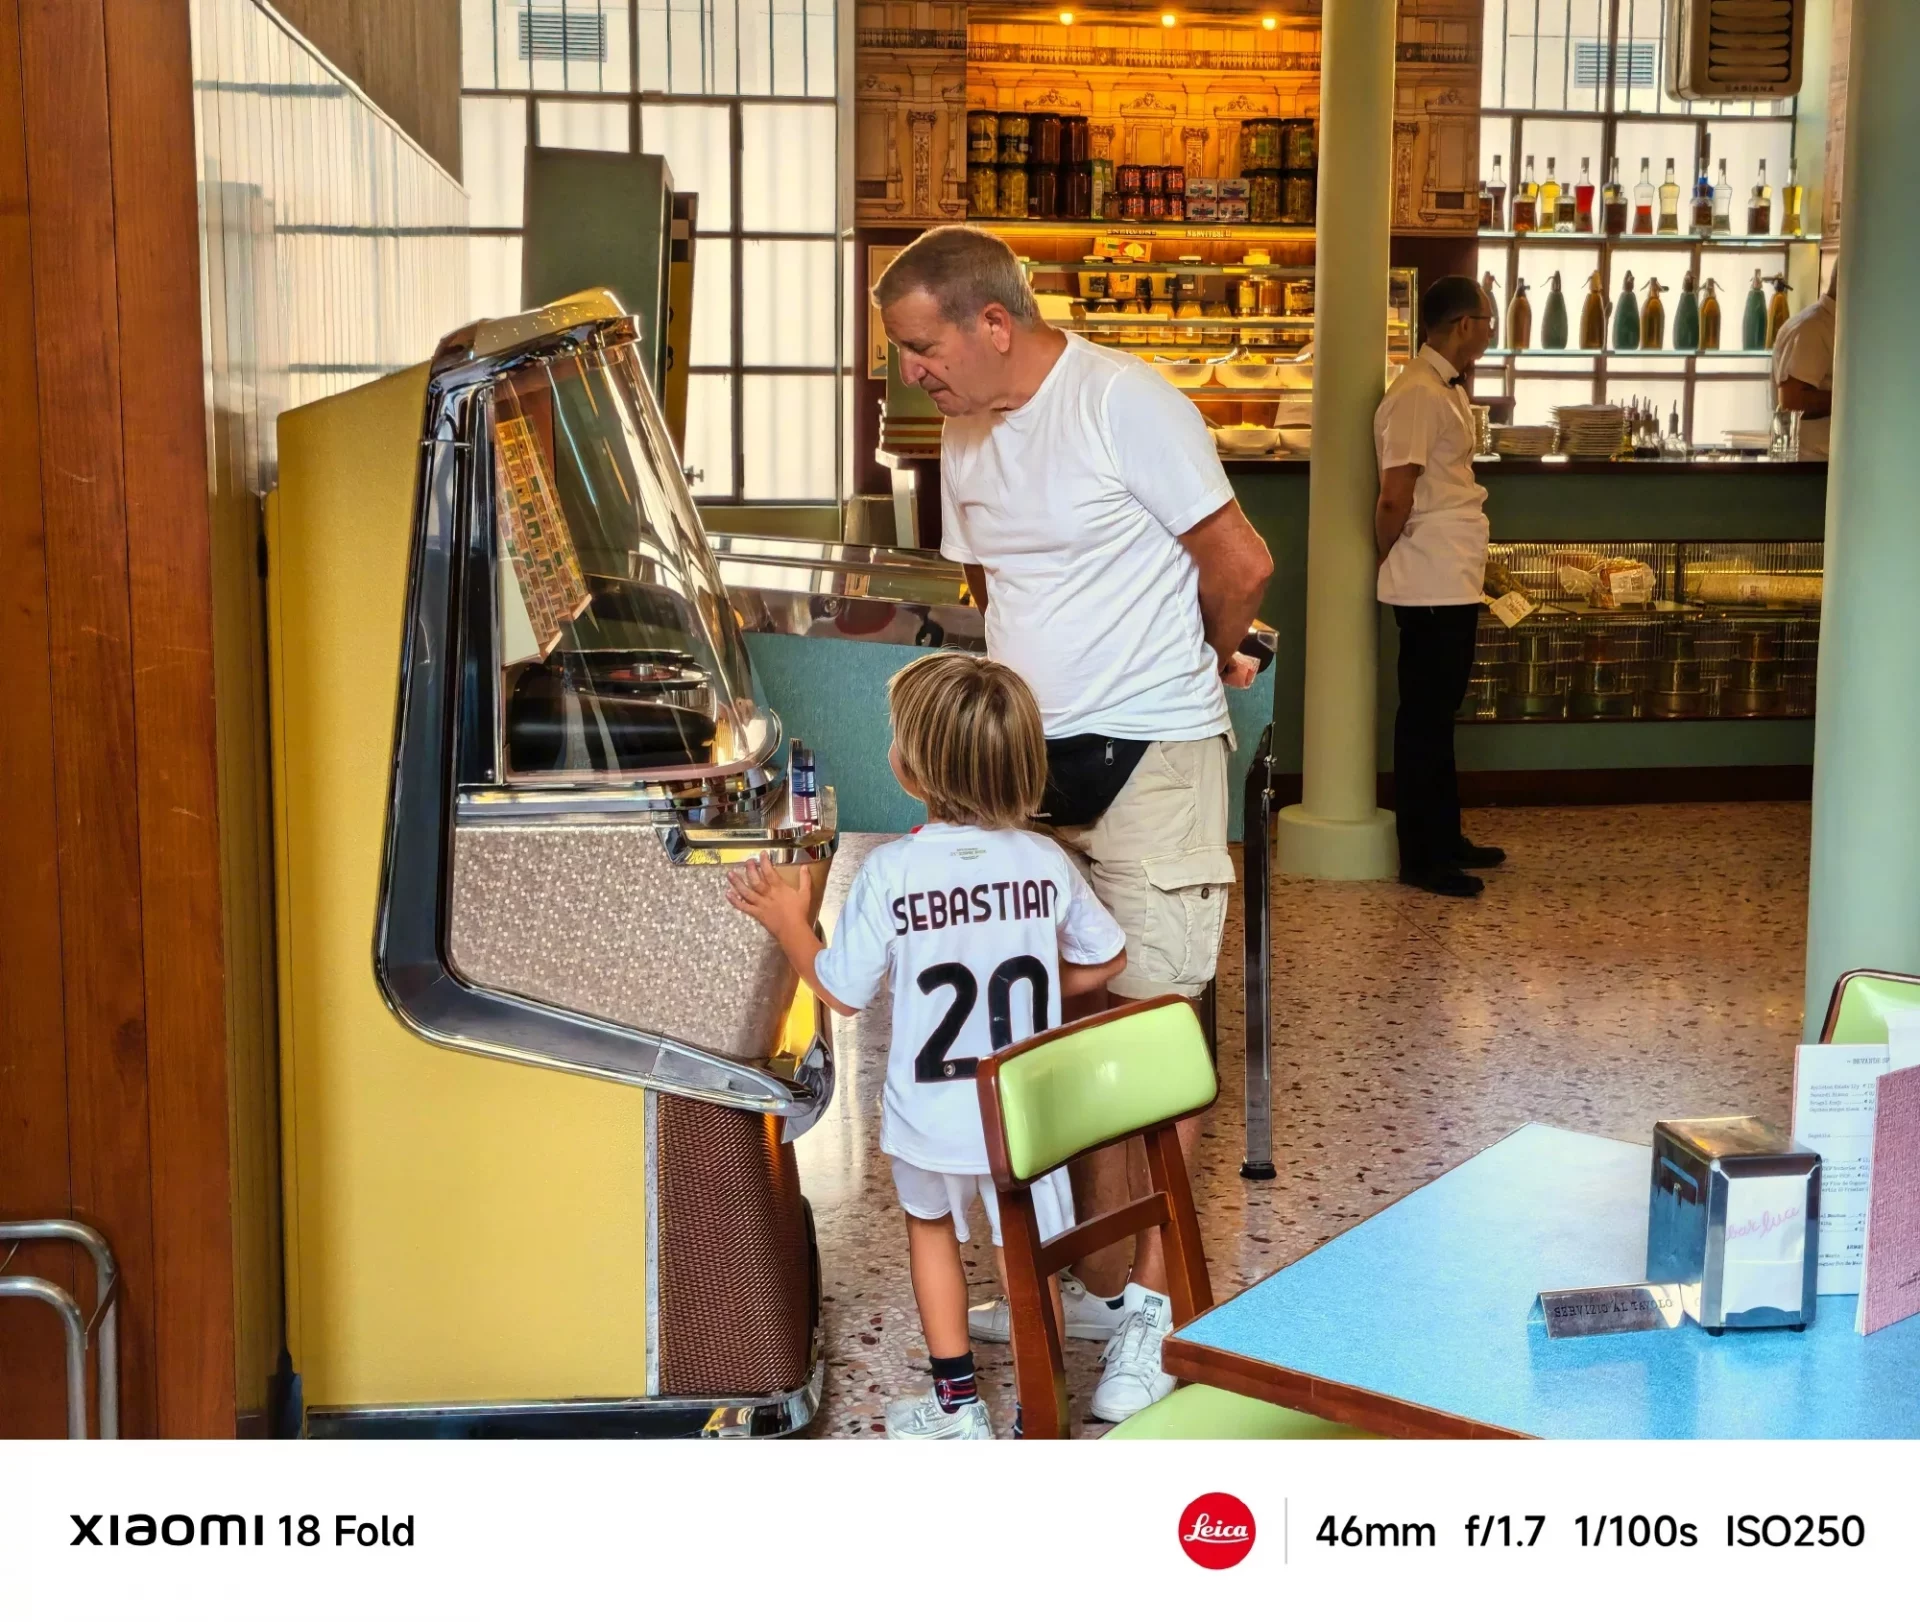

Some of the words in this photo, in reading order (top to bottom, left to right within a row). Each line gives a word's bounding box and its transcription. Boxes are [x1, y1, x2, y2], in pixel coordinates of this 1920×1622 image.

[915, 955, 1049, 1083] 20
[1760, 1208, 1799, 1239] luce
[1554, 1303, 1609, 1318] SERVIZIO
[1613, 1302, 1628, 1312] AL
[1630, 1298, 1673, 1311] TAVOLO
